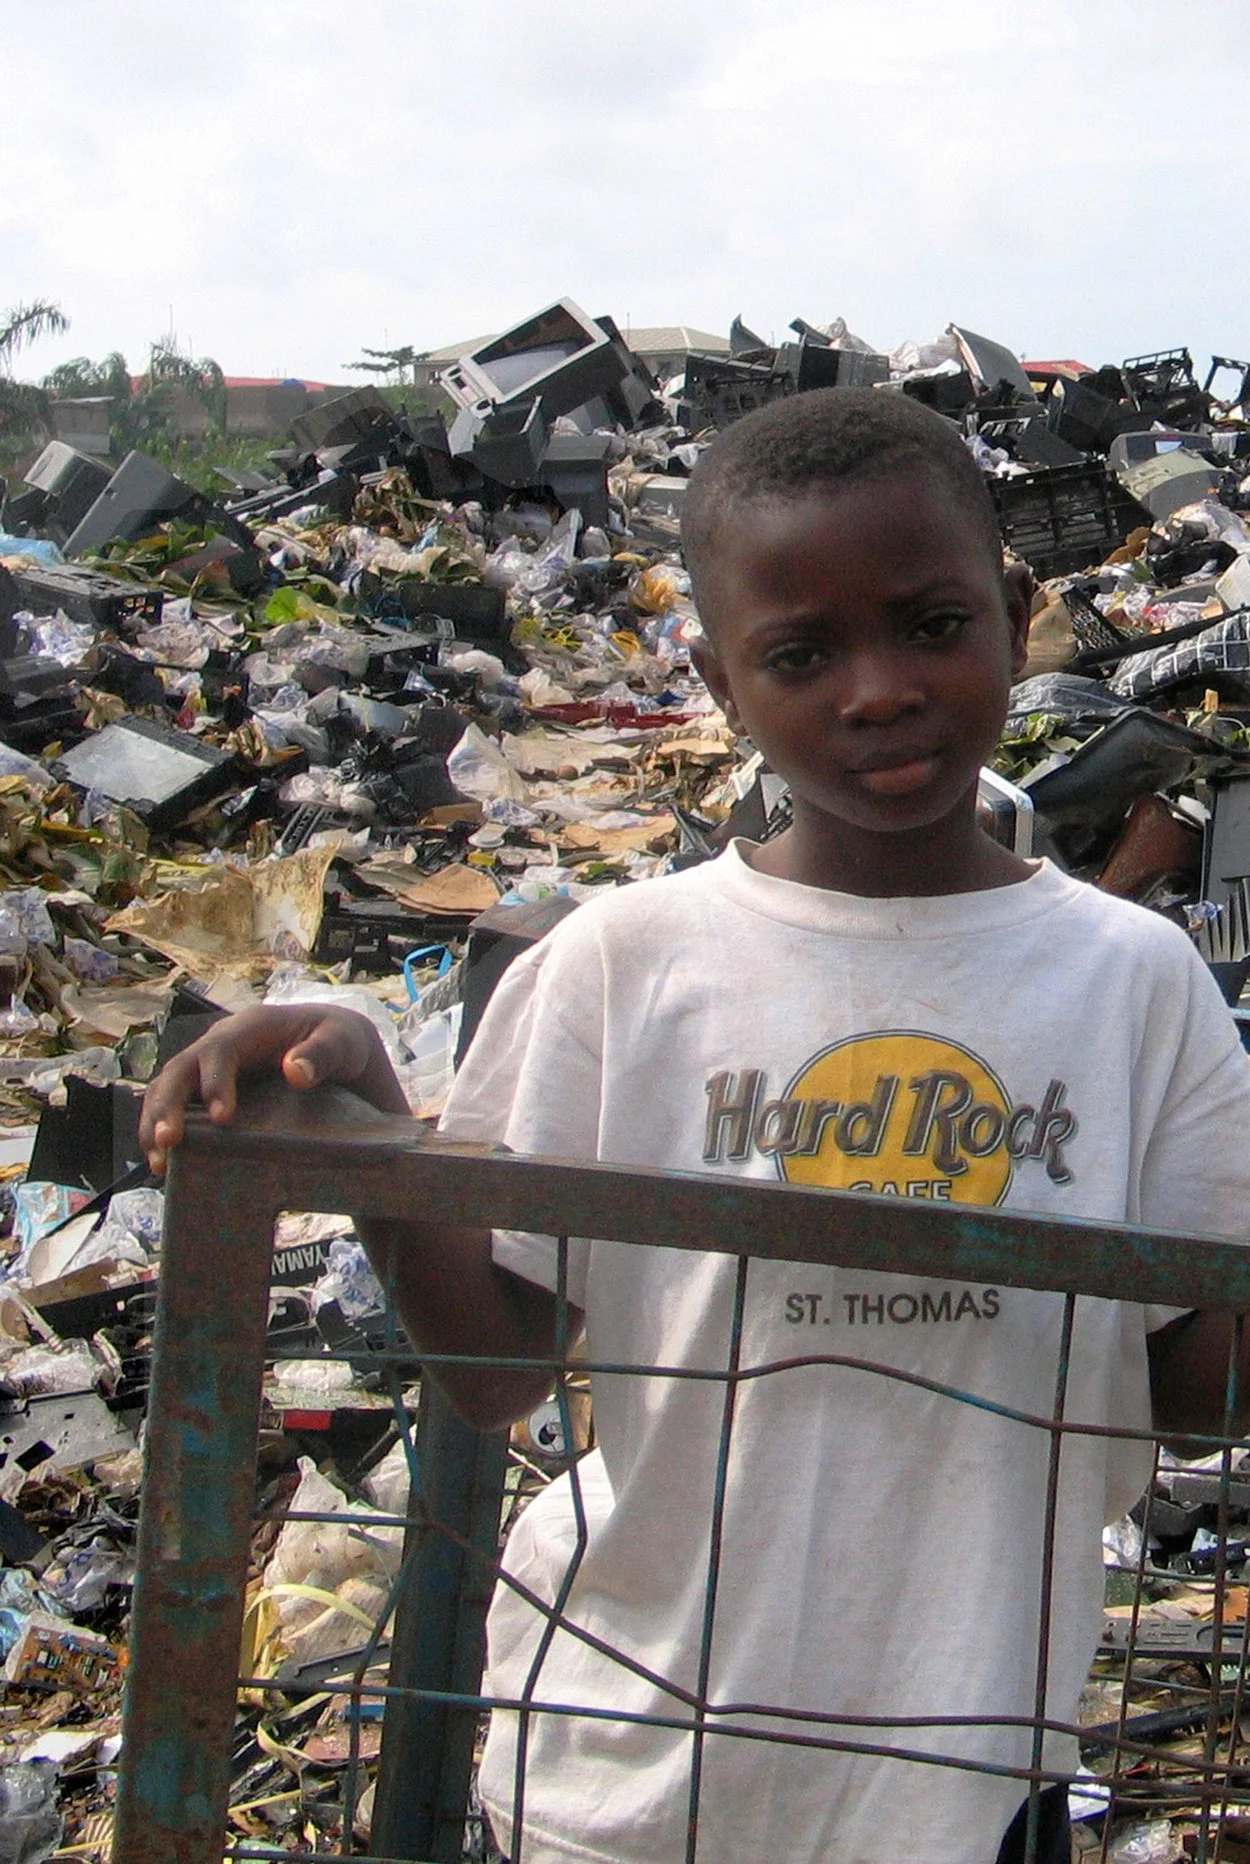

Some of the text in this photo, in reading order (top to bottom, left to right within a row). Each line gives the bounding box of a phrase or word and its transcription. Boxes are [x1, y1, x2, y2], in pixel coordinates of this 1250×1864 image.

[702, 1069, 1077, 1184] Hard Rock
[785, 1289, 1001, 1325] ST. THOMAS
